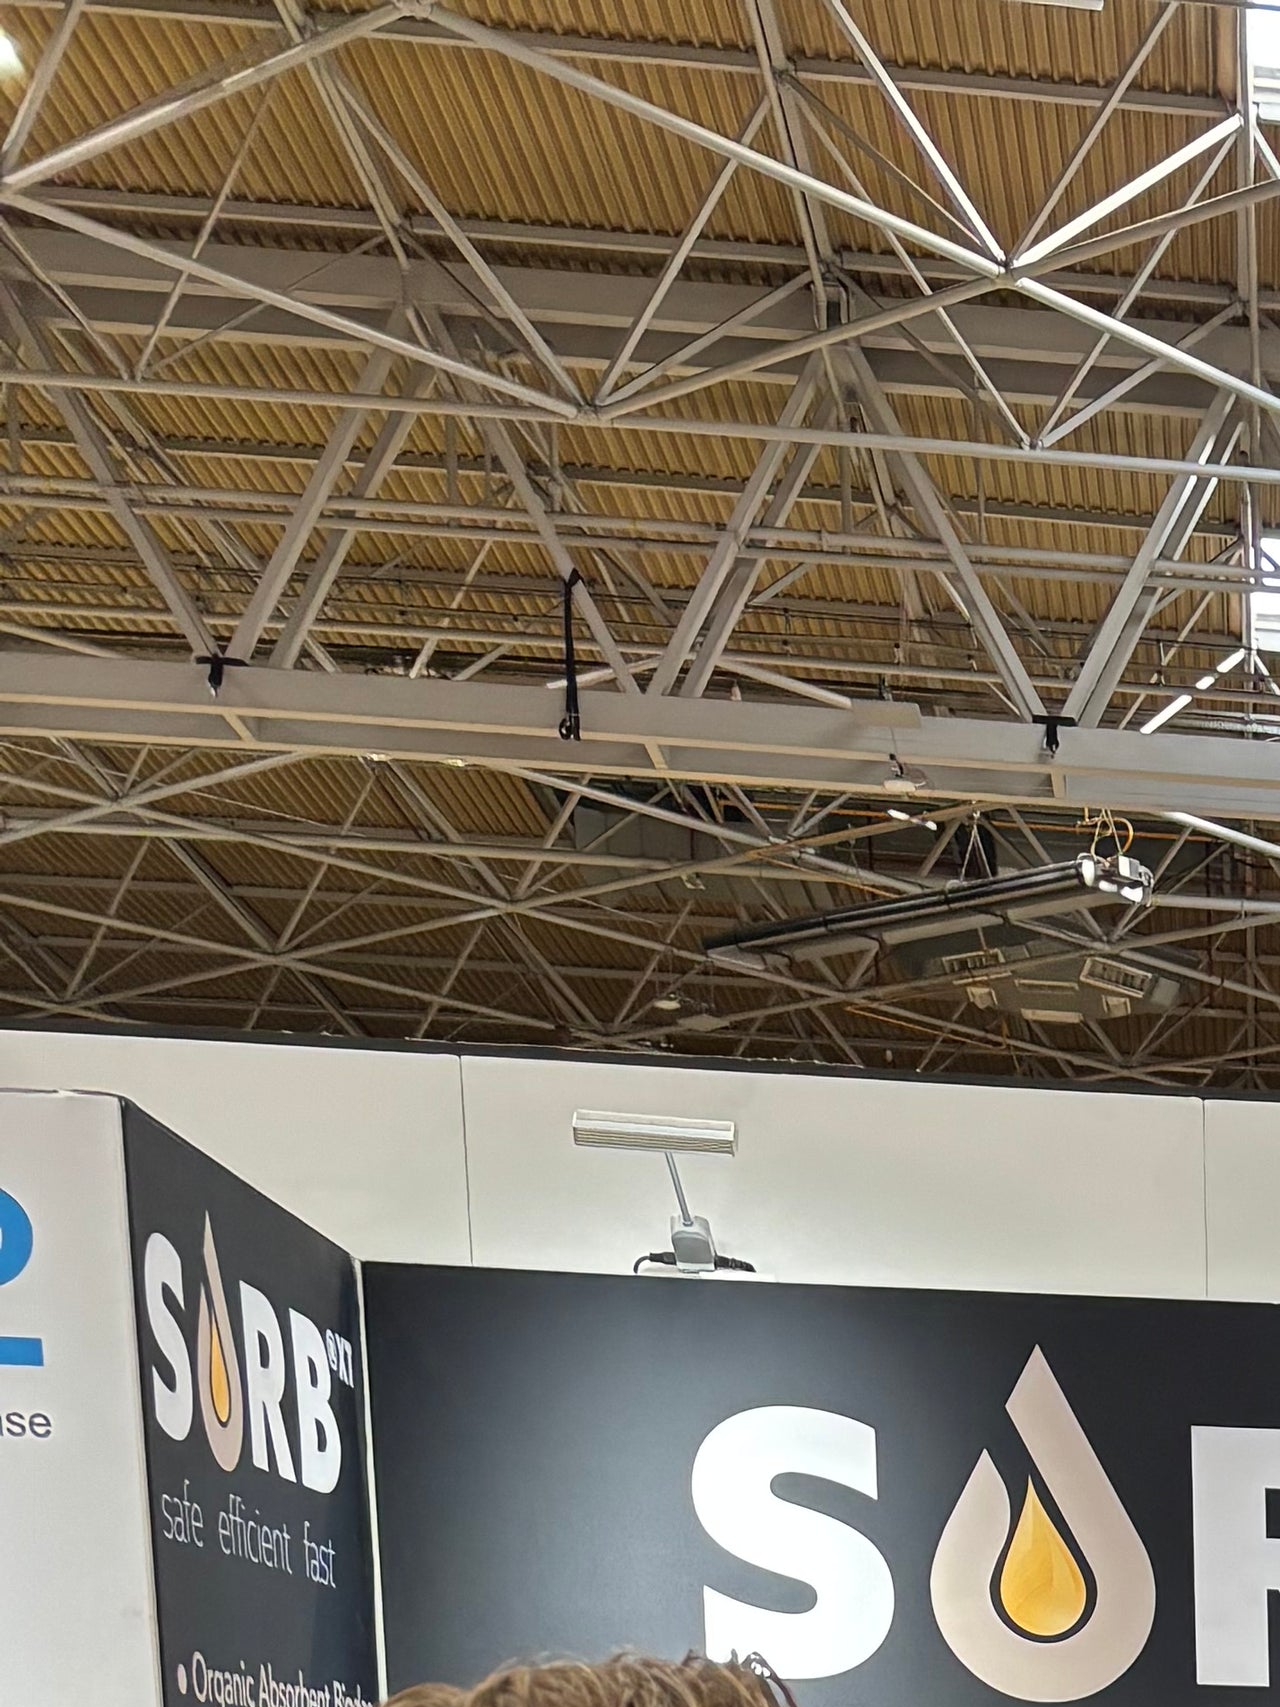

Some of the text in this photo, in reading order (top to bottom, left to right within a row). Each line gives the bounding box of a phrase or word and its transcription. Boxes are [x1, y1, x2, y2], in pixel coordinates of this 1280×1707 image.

[0, 1411, 52, 1440] se
[162, 1478, 337, 1589] safe efficient fast
